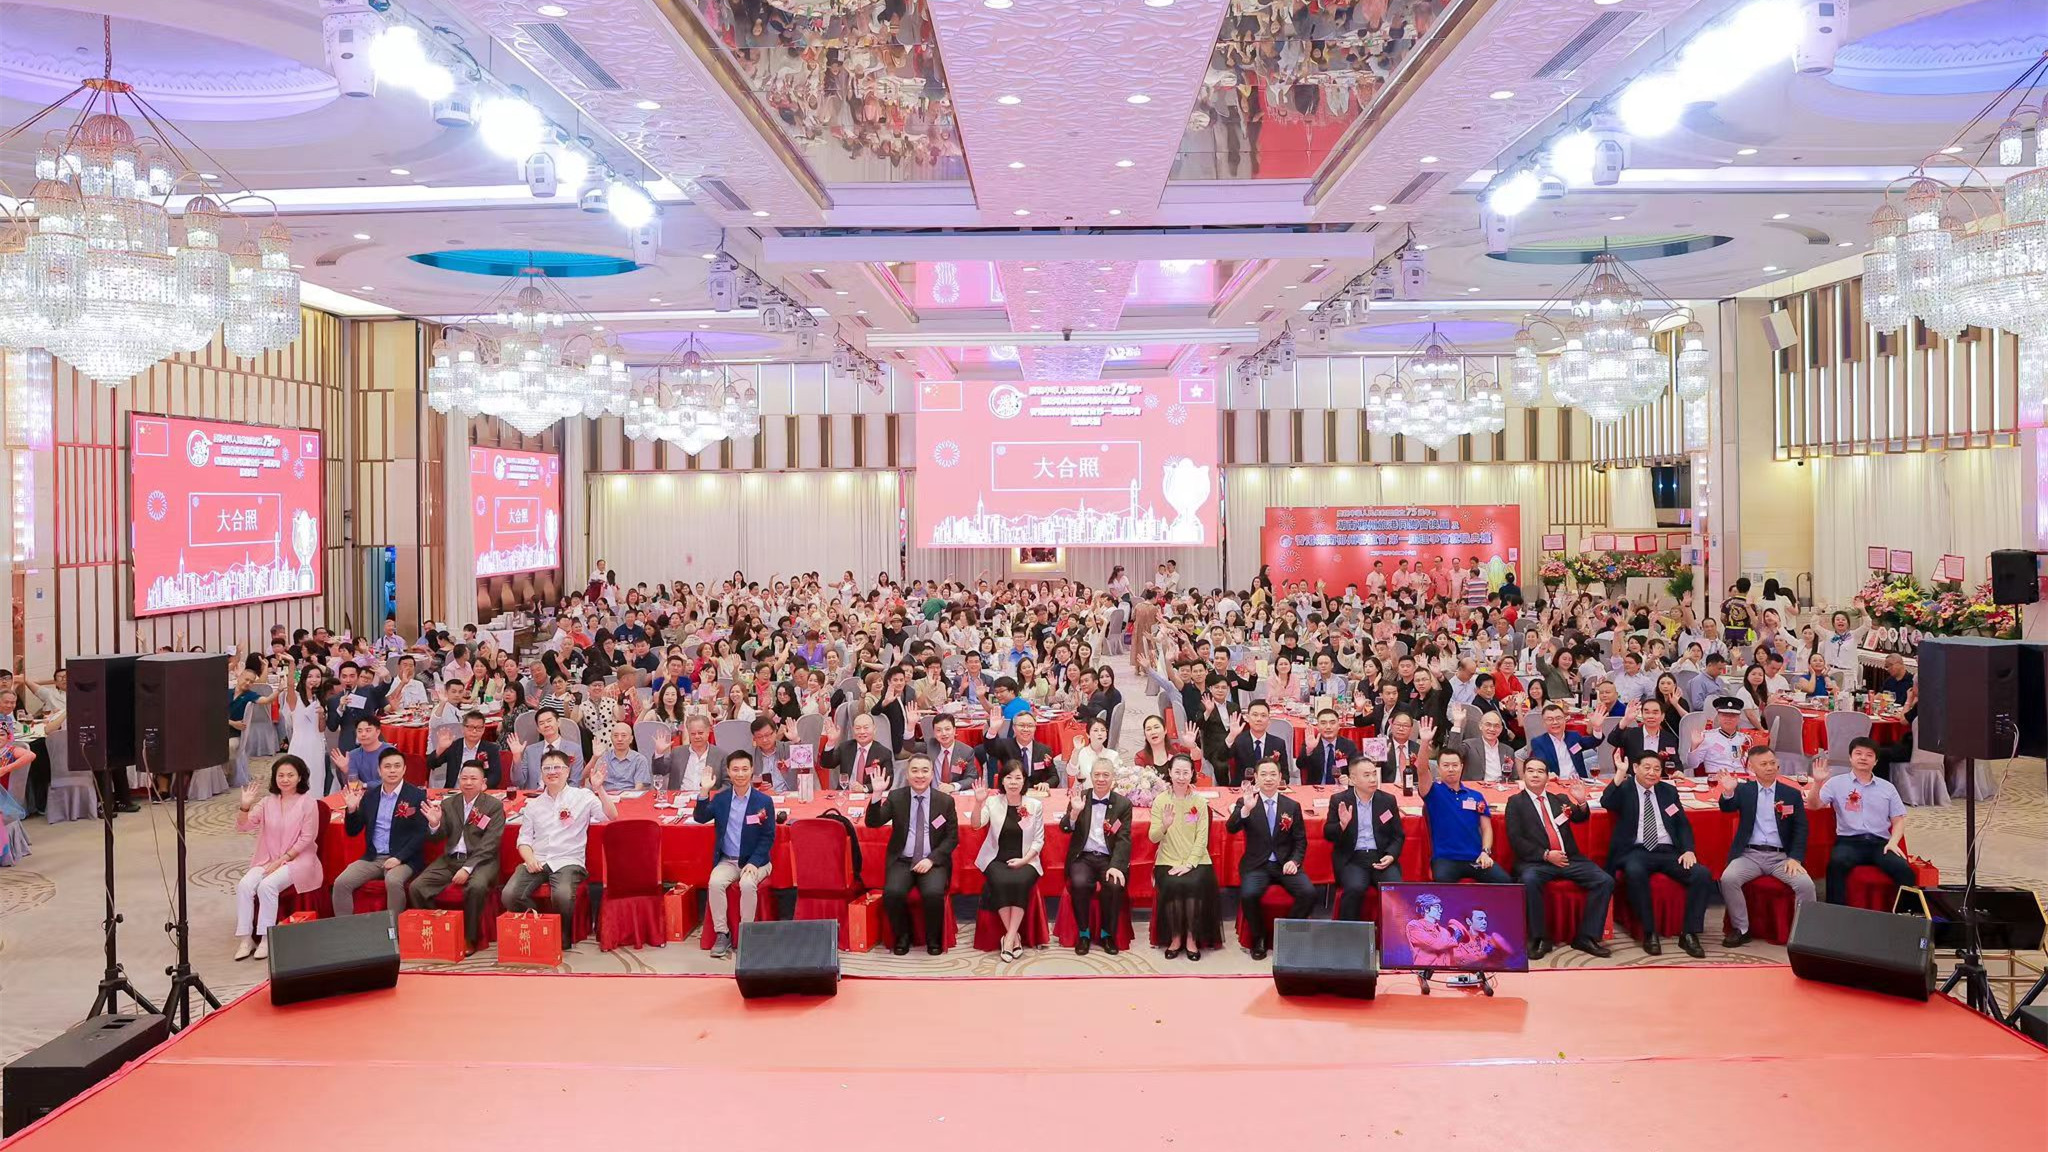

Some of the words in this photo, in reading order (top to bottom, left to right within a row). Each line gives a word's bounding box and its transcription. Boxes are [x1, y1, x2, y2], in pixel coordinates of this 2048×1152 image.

[1033, 457, 1100, 478] 大合照
[217, 509, 258, 533] 大合照
